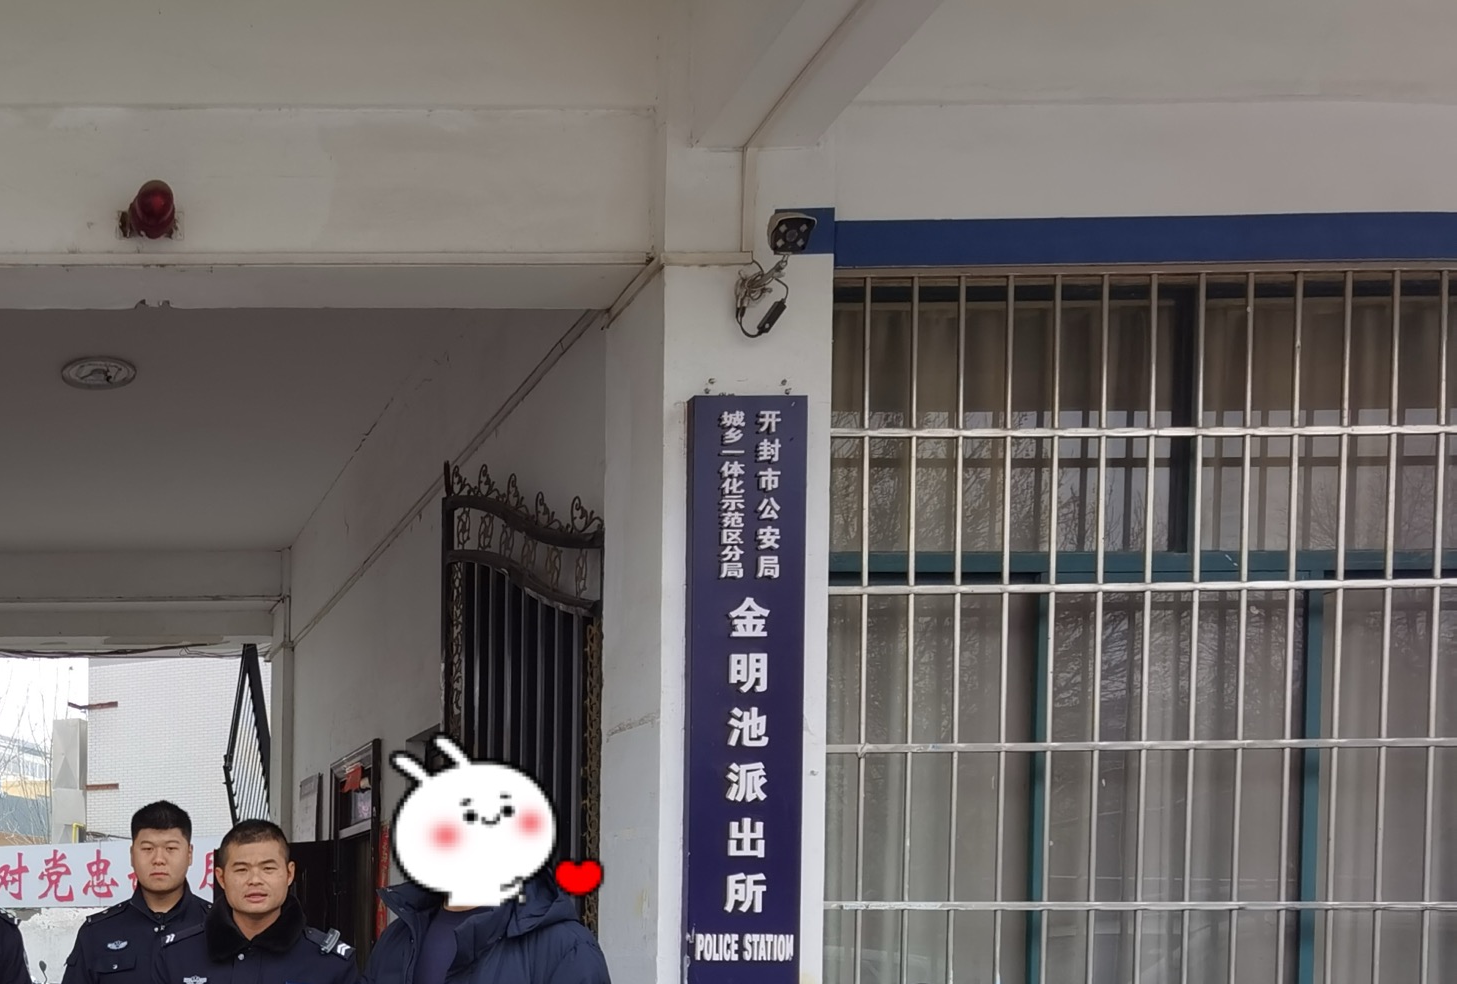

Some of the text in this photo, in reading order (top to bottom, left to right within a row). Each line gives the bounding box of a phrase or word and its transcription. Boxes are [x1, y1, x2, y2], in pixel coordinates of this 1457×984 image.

[718, 410, 746, 580] 城乡一体化示范区分局
[755, 410, 782, 580] 开封市公安局
[724, 596, 771, 914] 金明池派出所
[695, 933, 794, 961] POLICE STATION
